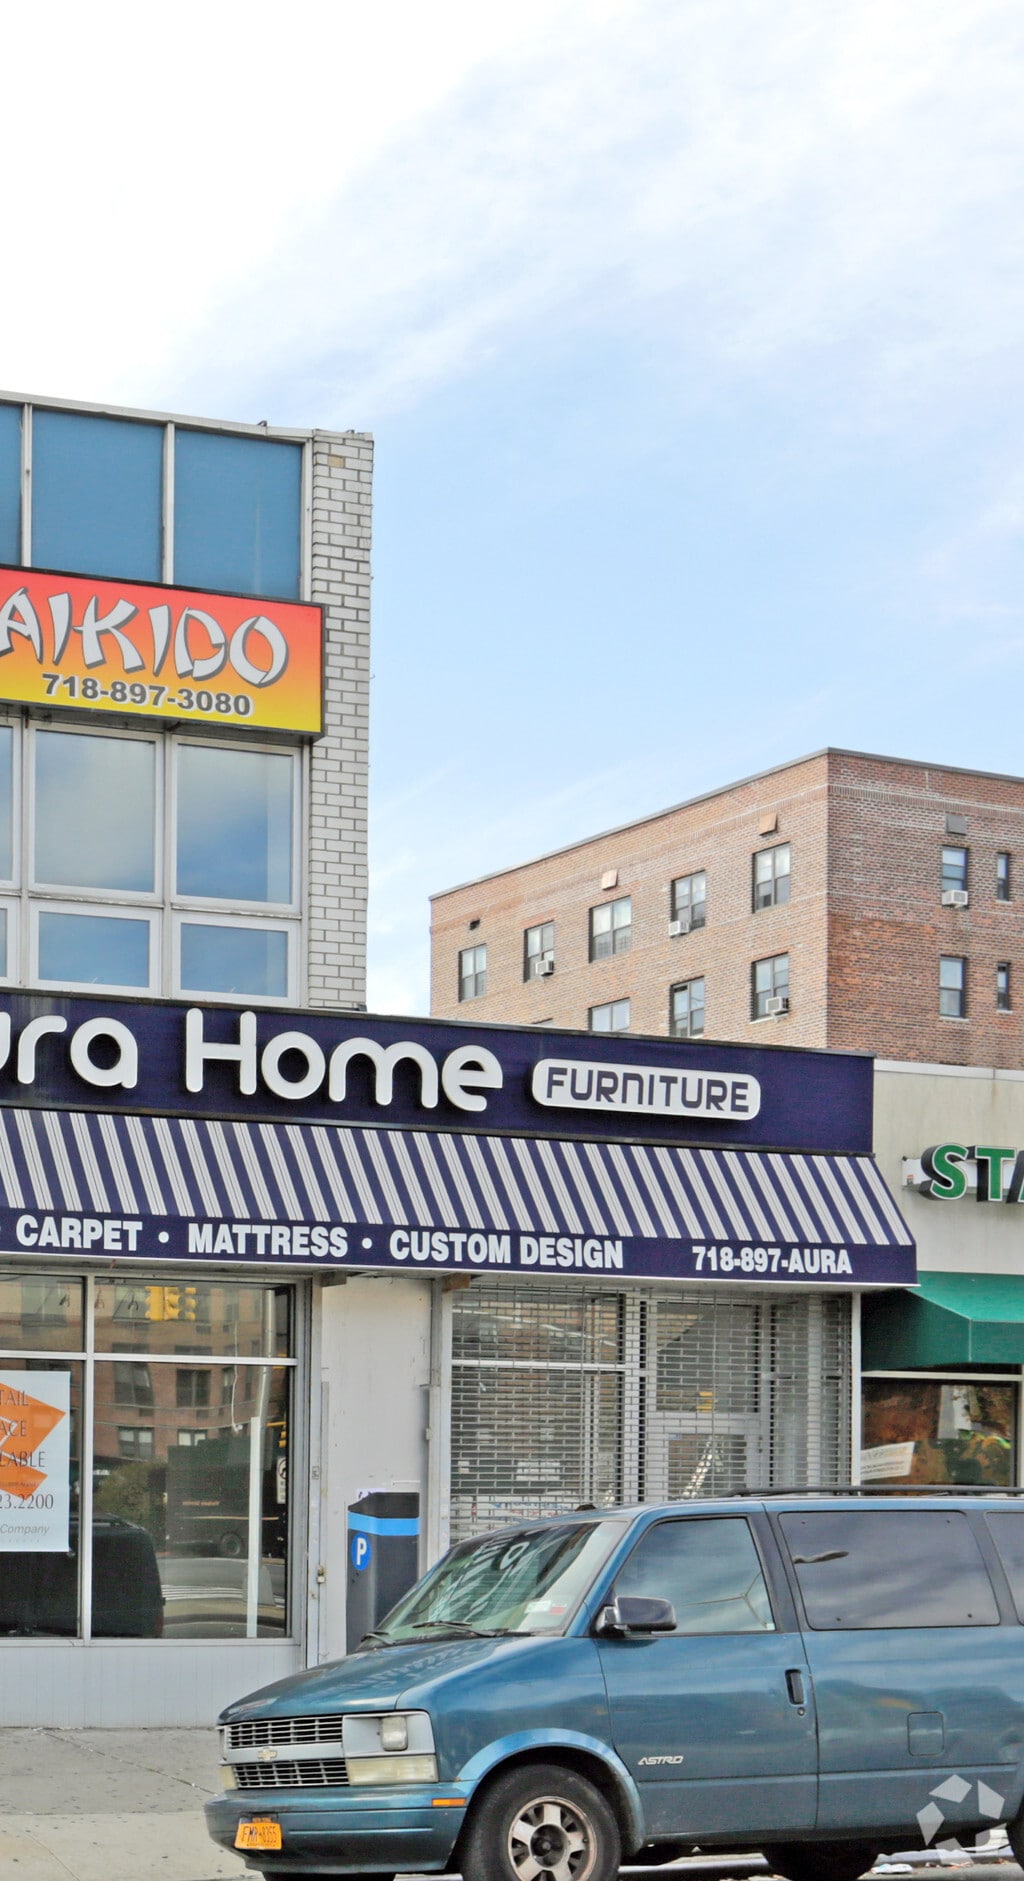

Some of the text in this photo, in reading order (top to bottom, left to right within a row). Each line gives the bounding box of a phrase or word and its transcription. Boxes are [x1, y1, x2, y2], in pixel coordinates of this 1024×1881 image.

[41, 672, 252, 717] 718-897-3080
[185, 1008, 504, 1112] Home
[545, 1066, 751, 1114] FURNITURE
[16, 1214, 143, 1253] CARPET
[187, 1222, 349, 1258] MATTRESS
[389, 1230, 512, 1264] CUSTOM
[520, 1236, 624, 1270] DESIGN
[691, 1246, 853, 1275] 718-897-AURA
[0, 1524, 50, 1536] Company
[637, 1755, 684, 1766] ASTRO
